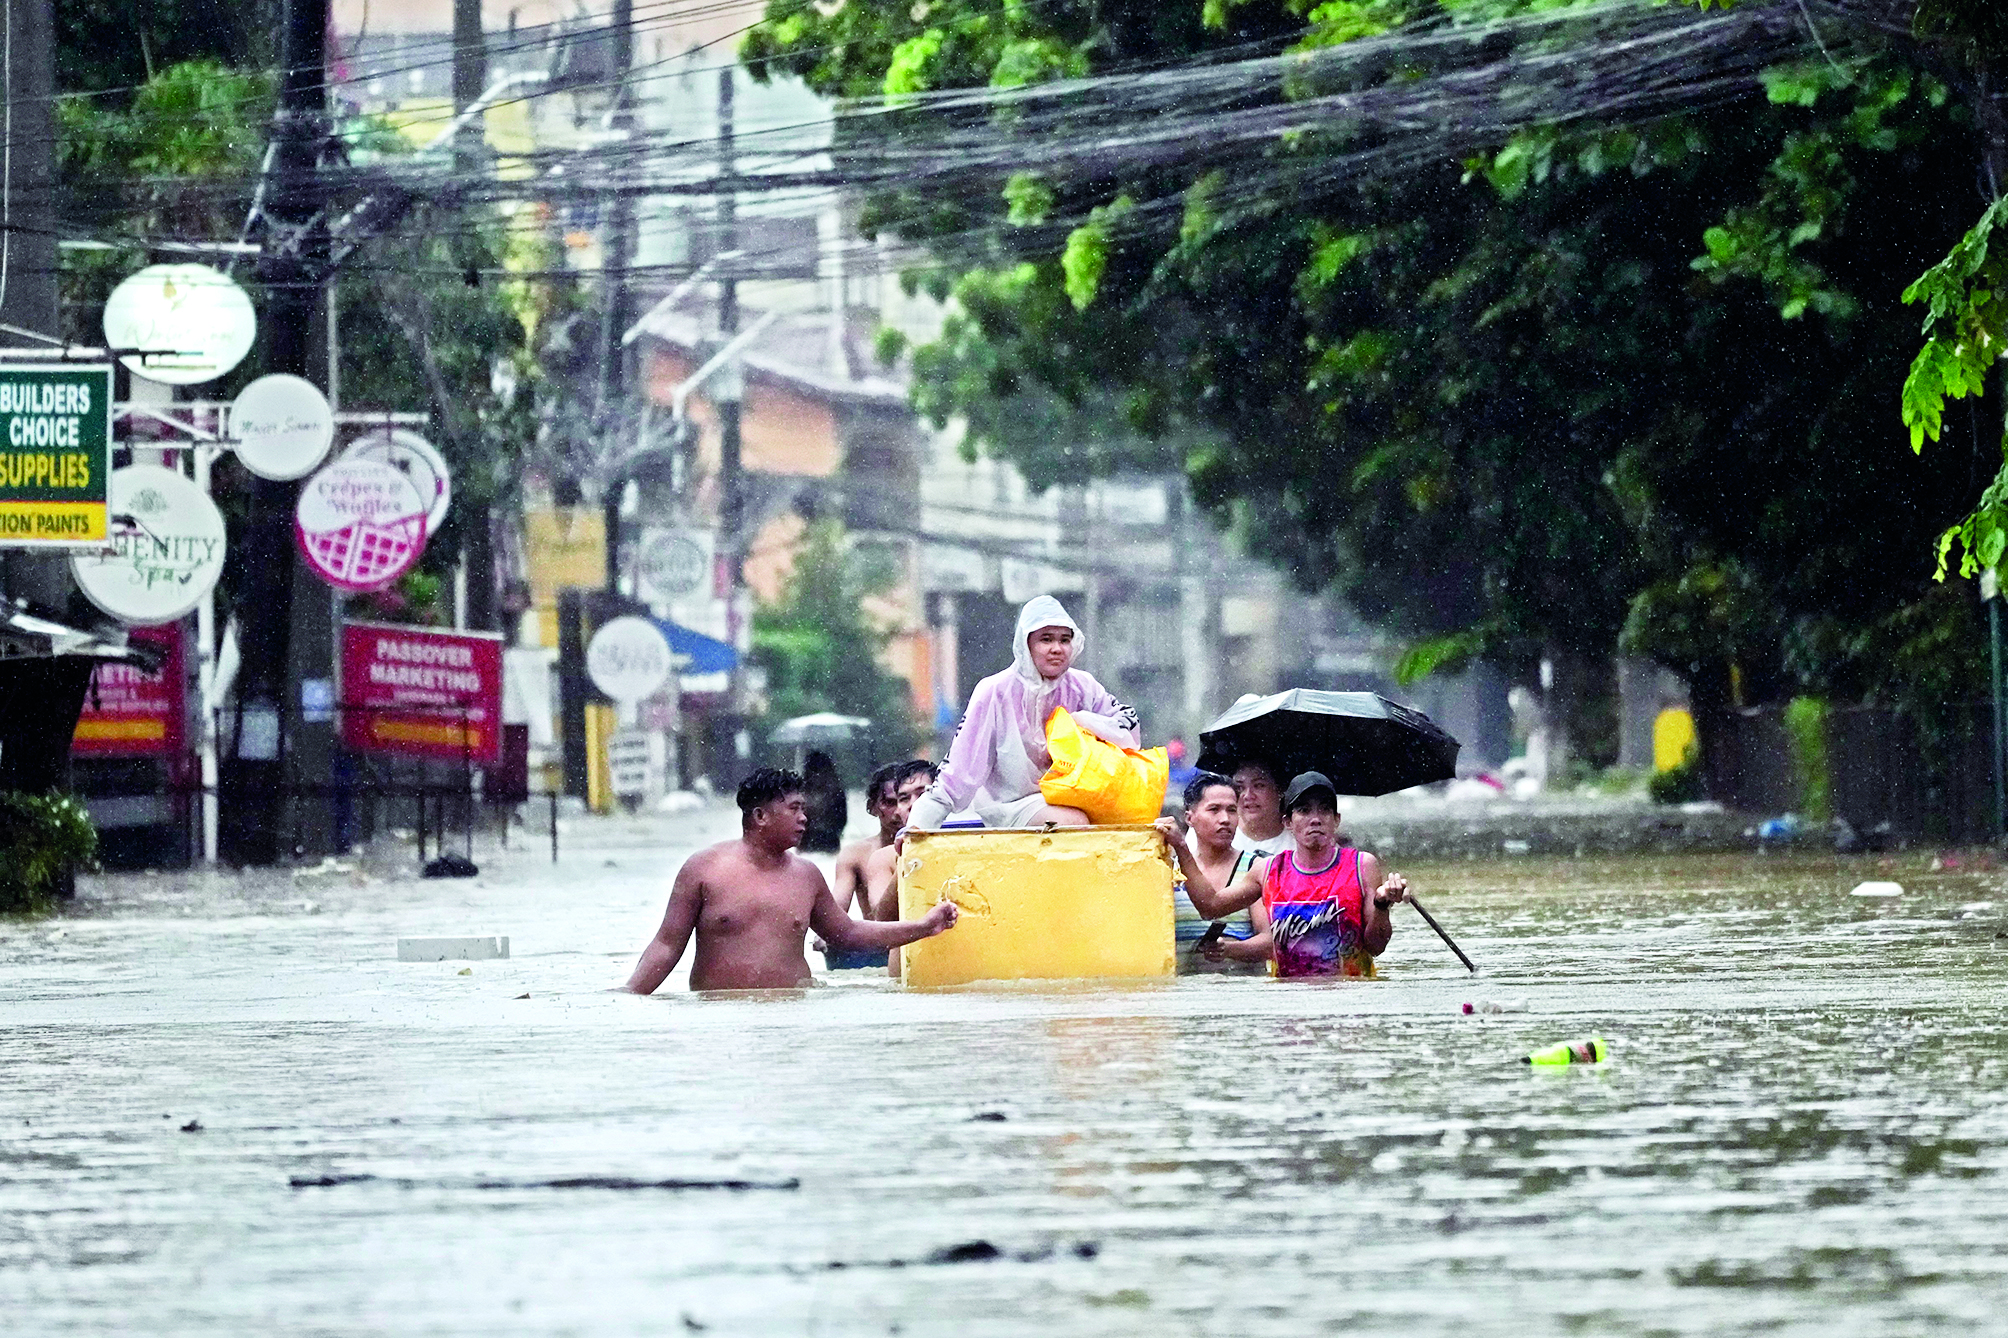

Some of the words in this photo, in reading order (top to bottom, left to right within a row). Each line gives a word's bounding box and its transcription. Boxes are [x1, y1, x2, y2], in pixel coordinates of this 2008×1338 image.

[0, 383, 90, 414] BUILDERS
[9, 416, 79, 447] CHOICE
[0, 453, 90, 488] SUPPLIES
[0, 514, 32, 534] ION
[37, 514, 89, 535] PAINTS
[128, 558, 176, 591] Spa
[377, 639, 472, 668] PASSOVER
[370, 662, 480, 692] MARKETING
